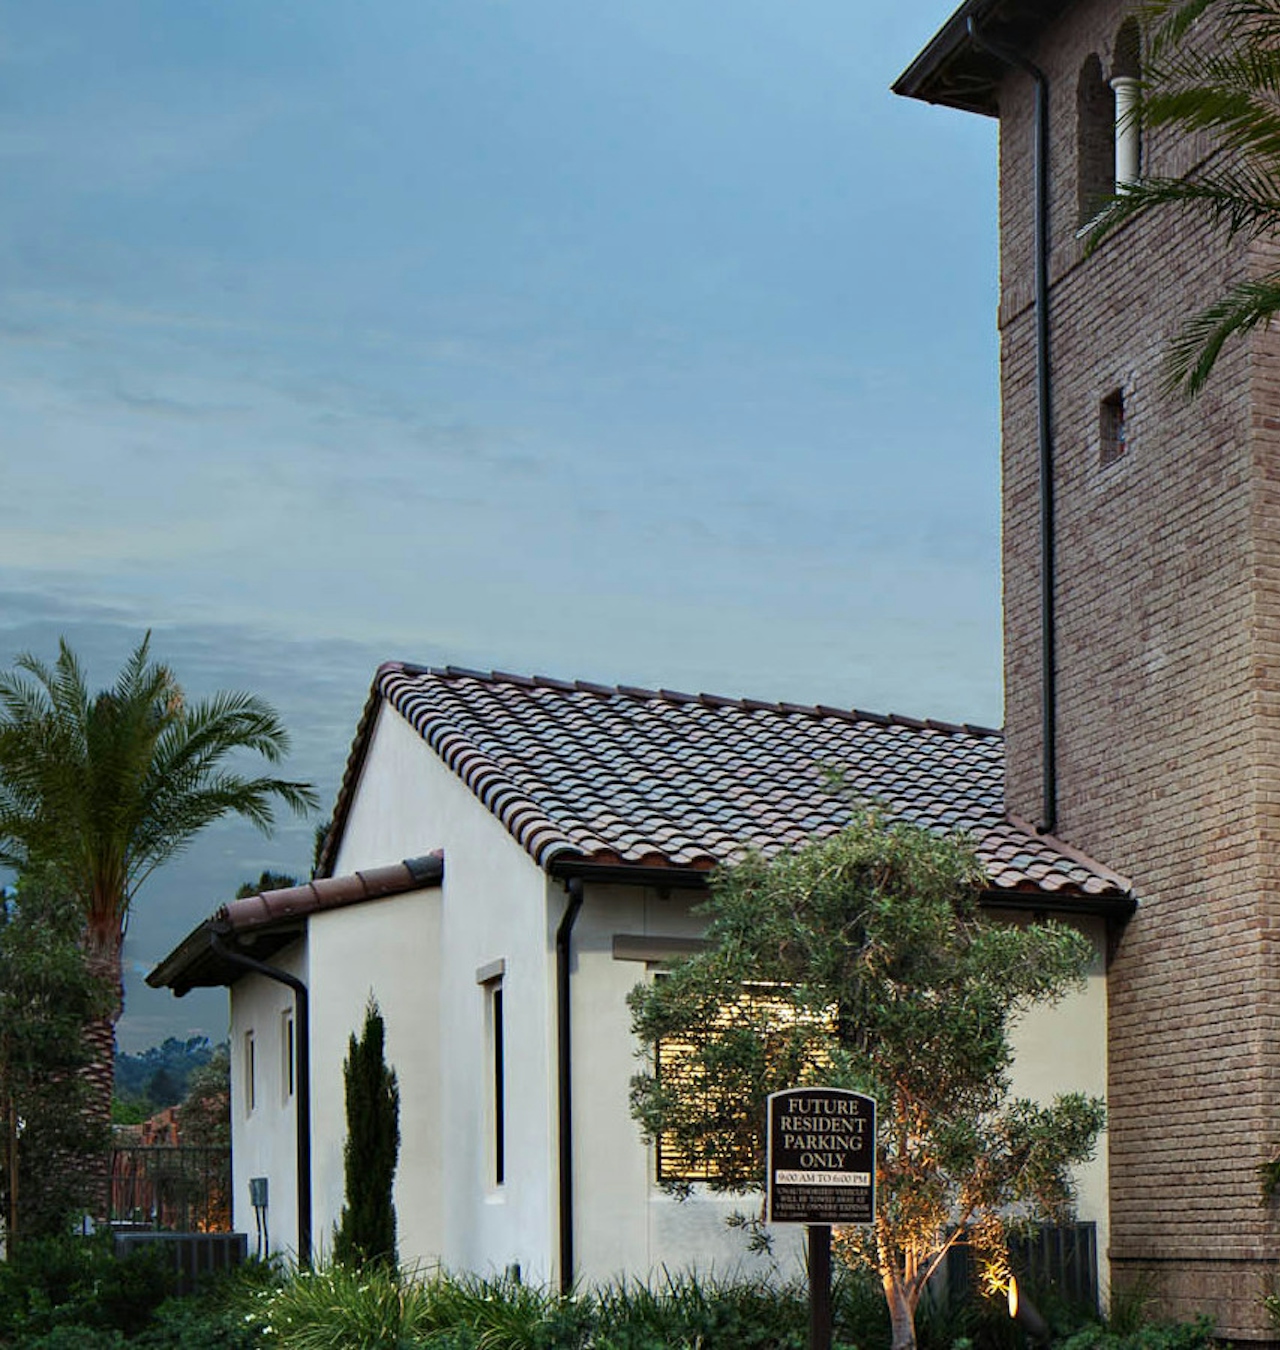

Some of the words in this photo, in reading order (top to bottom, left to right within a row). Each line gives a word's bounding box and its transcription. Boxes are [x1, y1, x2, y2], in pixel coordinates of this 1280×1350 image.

[788, 1098, 859, 1115] FUTURE
[780, 1116, 866, 1133] RESIDENT
[784, 1134, 862, 1151] PARKING
[800, 1152, 846, 1168] ONLY
[800, 1174, 815, 1182] AM
[817, 1174, 832, 1183] TO
[833, 1174, 851, 1183] 6:00
[853, 1175, 868, 1183] PM
